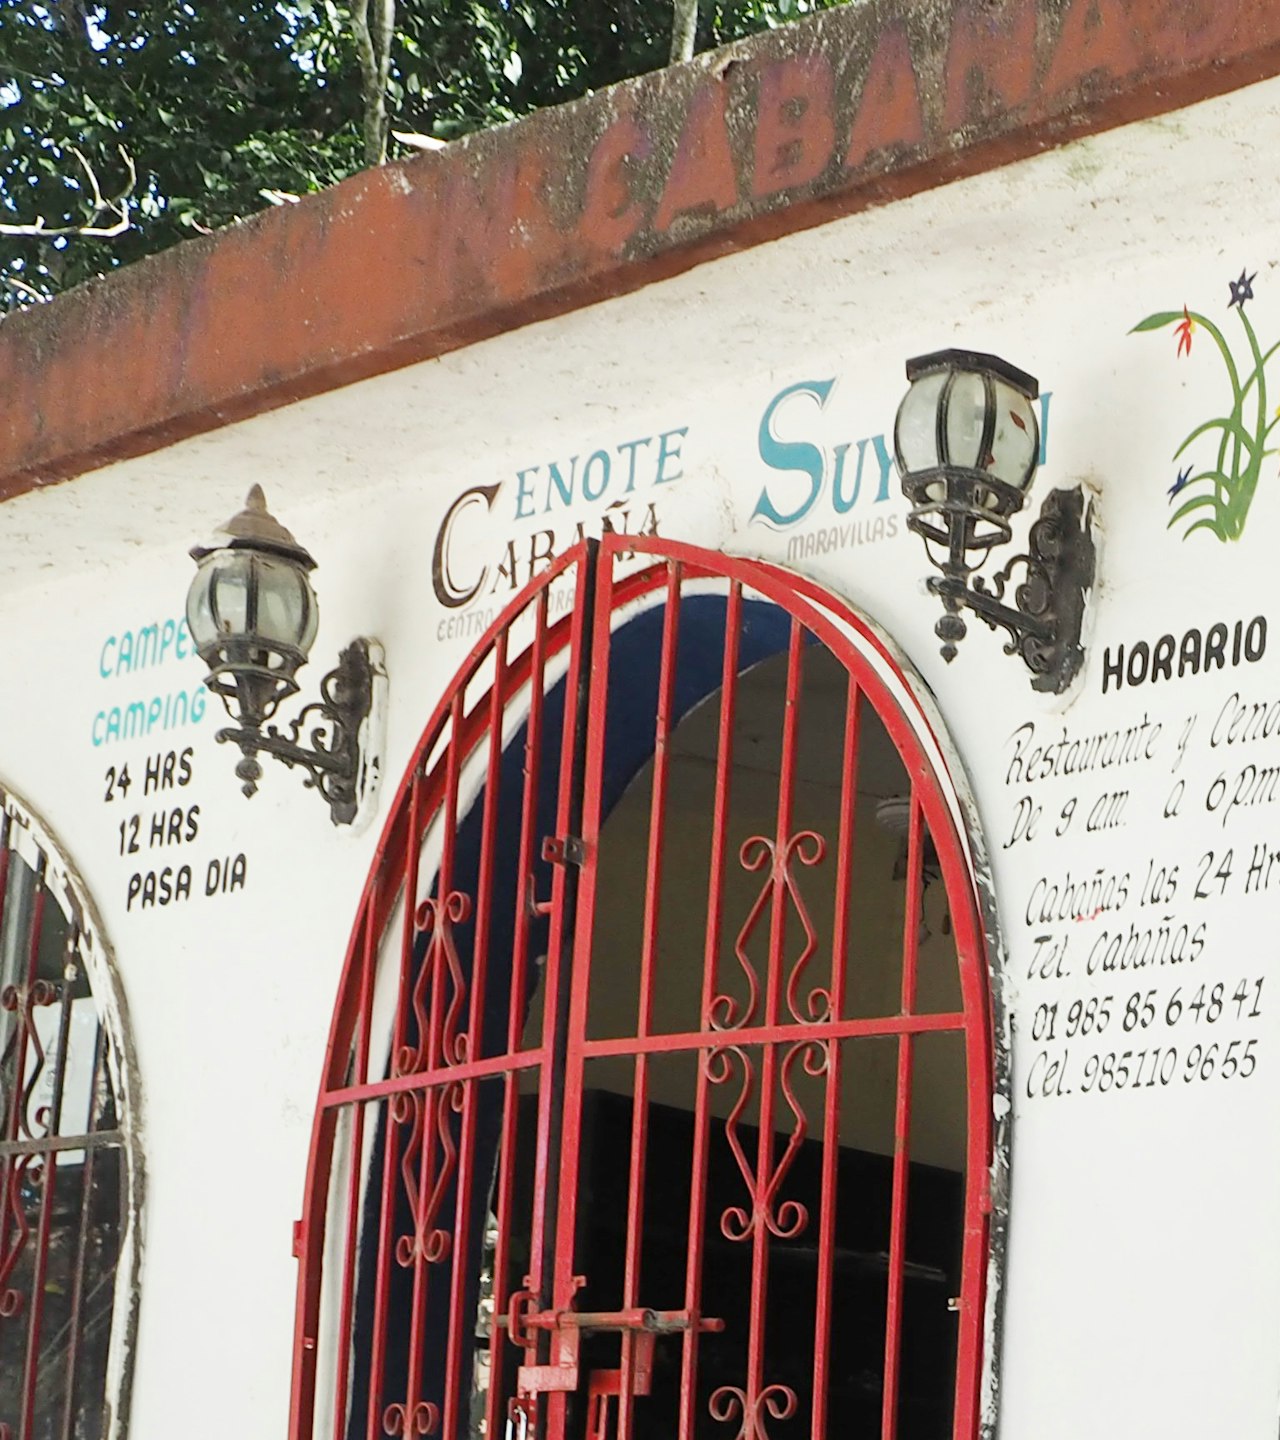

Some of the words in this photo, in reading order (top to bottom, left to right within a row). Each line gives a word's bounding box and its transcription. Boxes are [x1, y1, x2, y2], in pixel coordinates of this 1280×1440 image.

[787, 514, 899, 562] MARAVILLAS
[99, 617, 199, 679] CAMPE
[1103, 615, 1267, 694] HORARIO
[91, 686, 207, 747] CAMPING
[104, 762, 132, 802] 24
[143, 746, 194, 797] HRS
[1004, 713, 1163, 786] Restaurante
[1173, 713, 1198, 774] y
[119, 814, 141, 856] 12
[150, 805, 200, 849] HRS
[1003, 796, 1043, 849] De
[1055, 797, 1078, 837] 9
[1164, 779, 1186, 818] a
[127, 864, 192, 913] PASA
[205, 852, 247, 897] DIA
[1026, 868, 1130, 927] Cabañas
[1140, 859, 1180, 908] las
[1194, 848, 1234, 900] 24
[1027, 934, 1071, 980] Tel.
[1032, 1001, 1058, 1041] 01
[1066, 995, 1114, 1038] 985
[1026, 1048, 1072, 1099] Cel.
